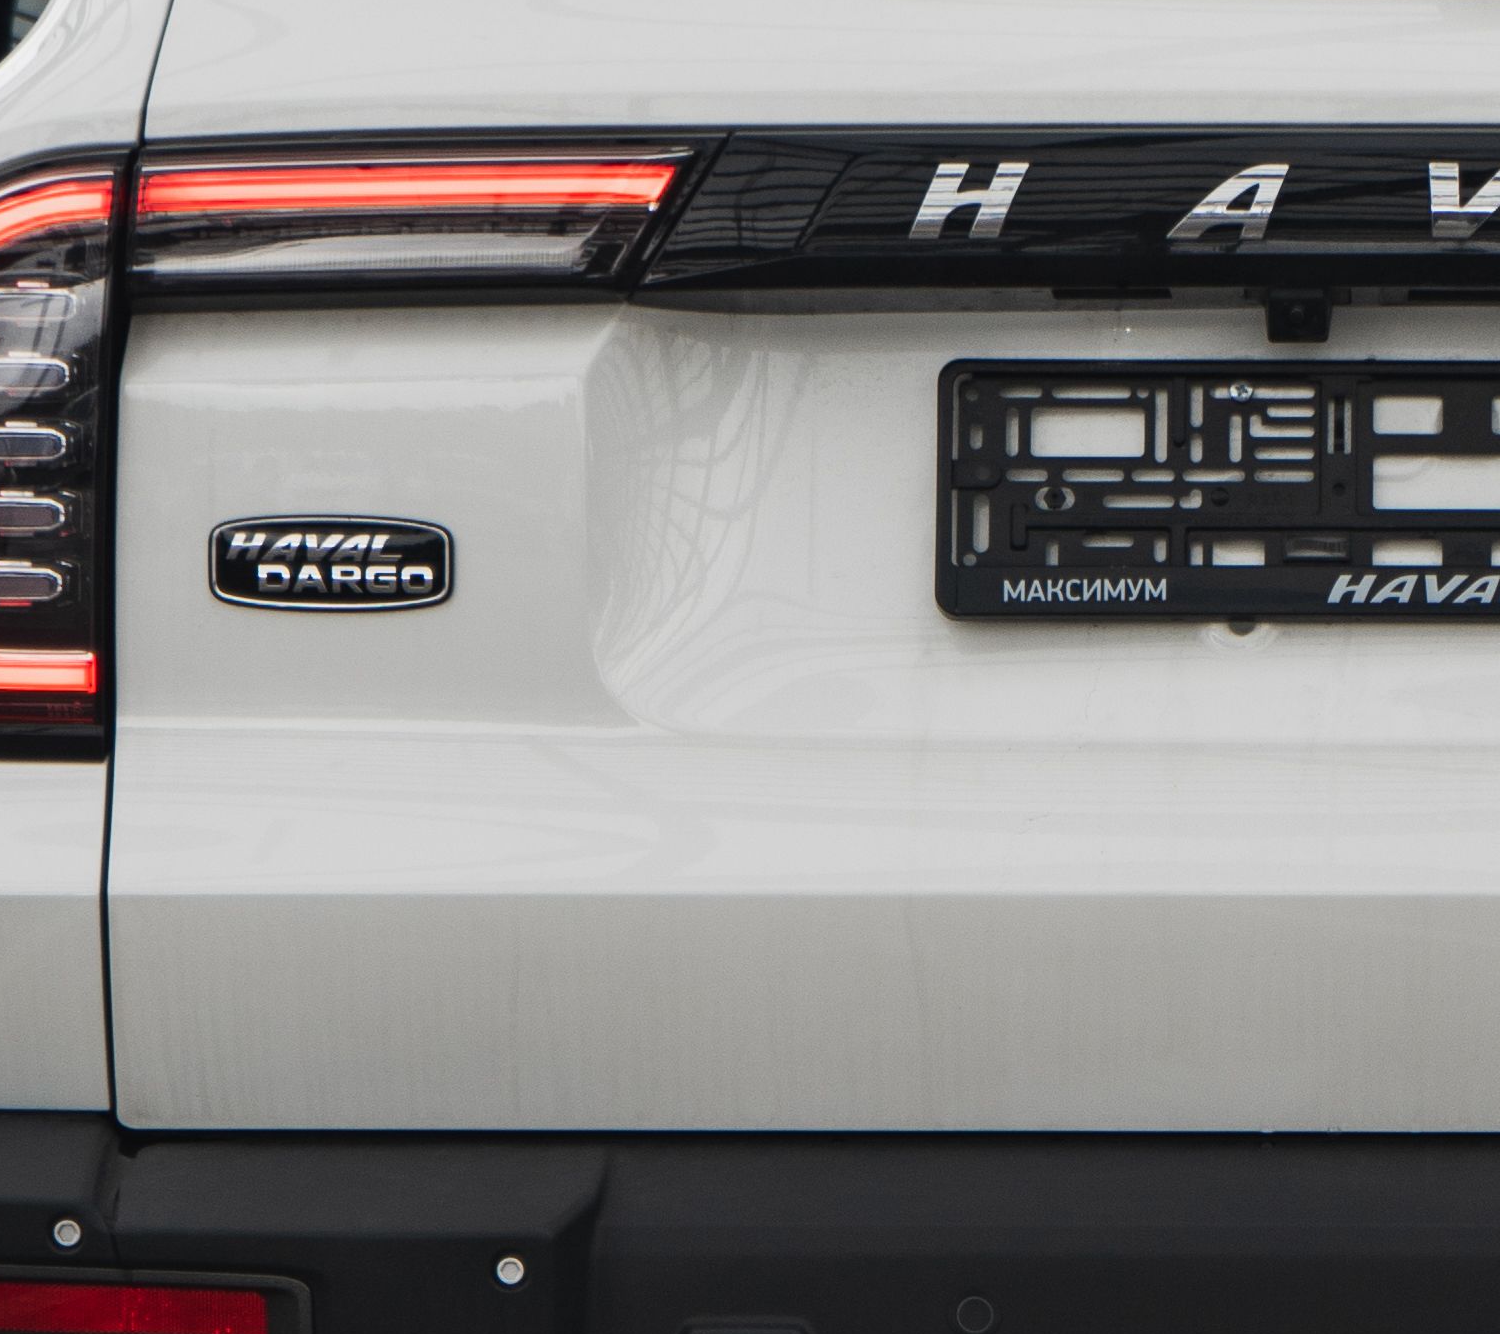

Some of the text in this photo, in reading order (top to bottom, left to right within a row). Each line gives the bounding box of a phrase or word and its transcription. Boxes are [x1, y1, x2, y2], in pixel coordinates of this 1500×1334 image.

[225, 531, 403, 563] HAVAL
[256, 563, 435, 595] DARGO
[1002, 577, 1168, 603] МАКСИМУМ
